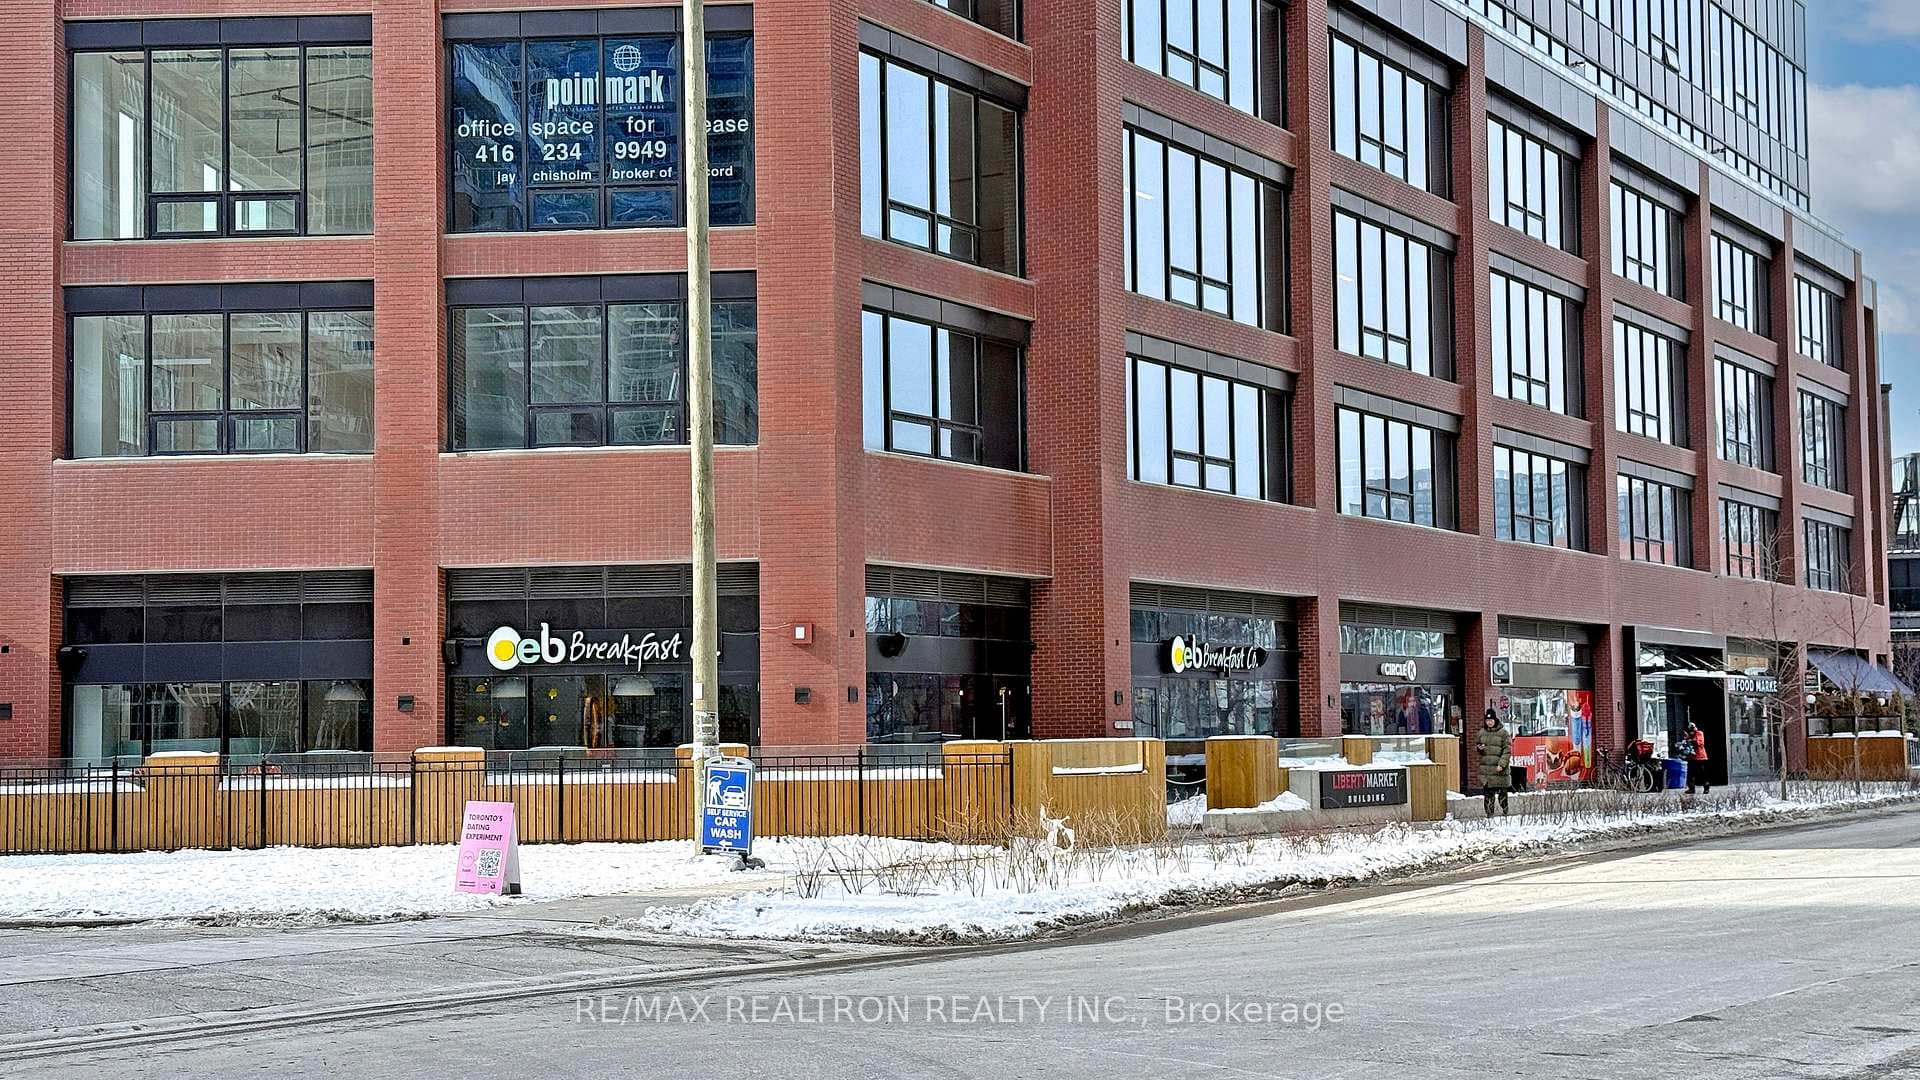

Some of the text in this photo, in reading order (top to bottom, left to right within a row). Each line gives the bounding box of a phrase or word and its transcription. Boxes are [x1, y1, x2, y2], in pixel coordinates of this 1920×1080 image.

[458, 116, 749, 139] office space for ease
[475, 140, 667, 163] 416 234 9949
[496, 171, 516, 185] jay
[532, 169, 592, 181] chisholm
[612, 167, 655, 180] broker
[659, 166, 673, 178] of
[569, 631, 682, 671] Breakfast
[1203, 642, 1245, 678] Breakfast
[1384, 662, 1416, 679] CIRCLE K
[1495, 662, 1507, 674] K
[1736, 679, 1754, 691] FOOD
[1756, 680, 1778, 692] MARKE
[1347, 793, 1385, 804] BUILDING
[469, 814, 503, 822] TORONTO'S
[707, 808, 747, 817] SELF SERVICE
[467, 823, 490, 831] DATING
[714, 816, 737, 827] CAR
[465, 833, 503, 841] EXPERIMENT
[710, 827, 741, 839] WASH
